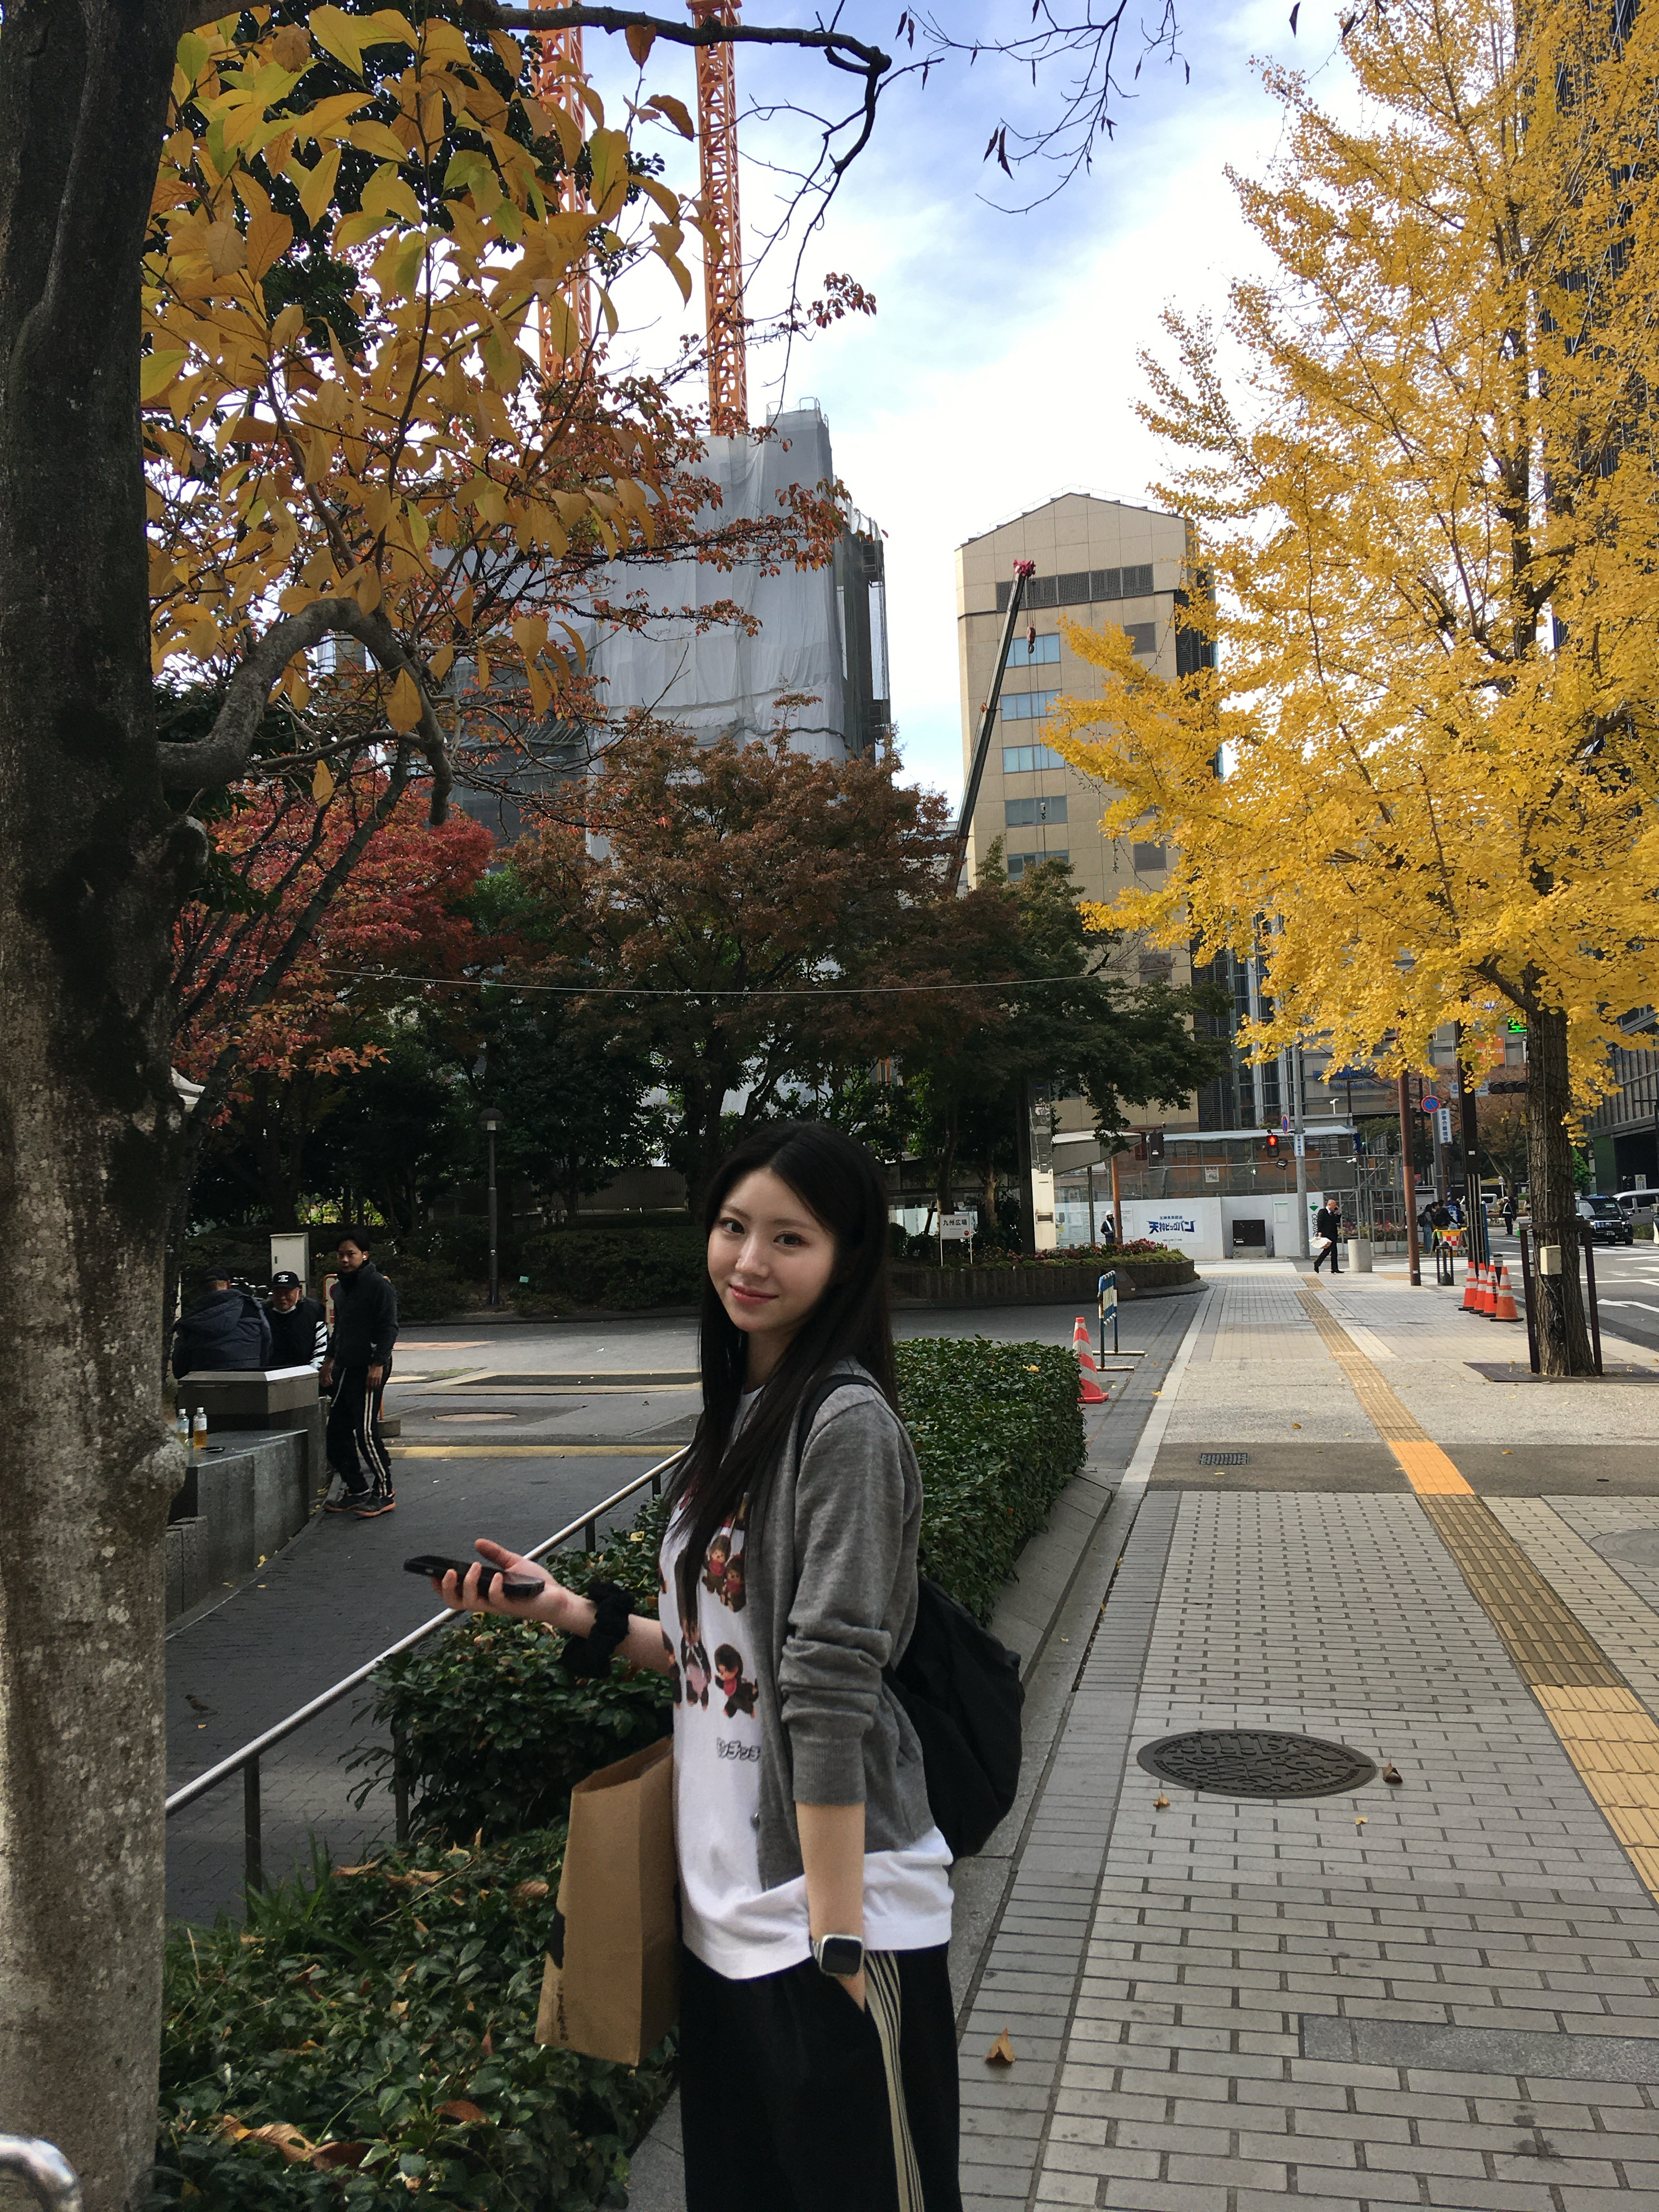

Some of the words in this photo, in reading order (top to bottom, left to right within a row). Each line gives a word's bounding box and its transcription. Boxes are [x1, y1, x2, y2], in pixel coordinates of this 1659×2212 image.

[1146, 1220, 1196, 1234] 天神ビッグバン
